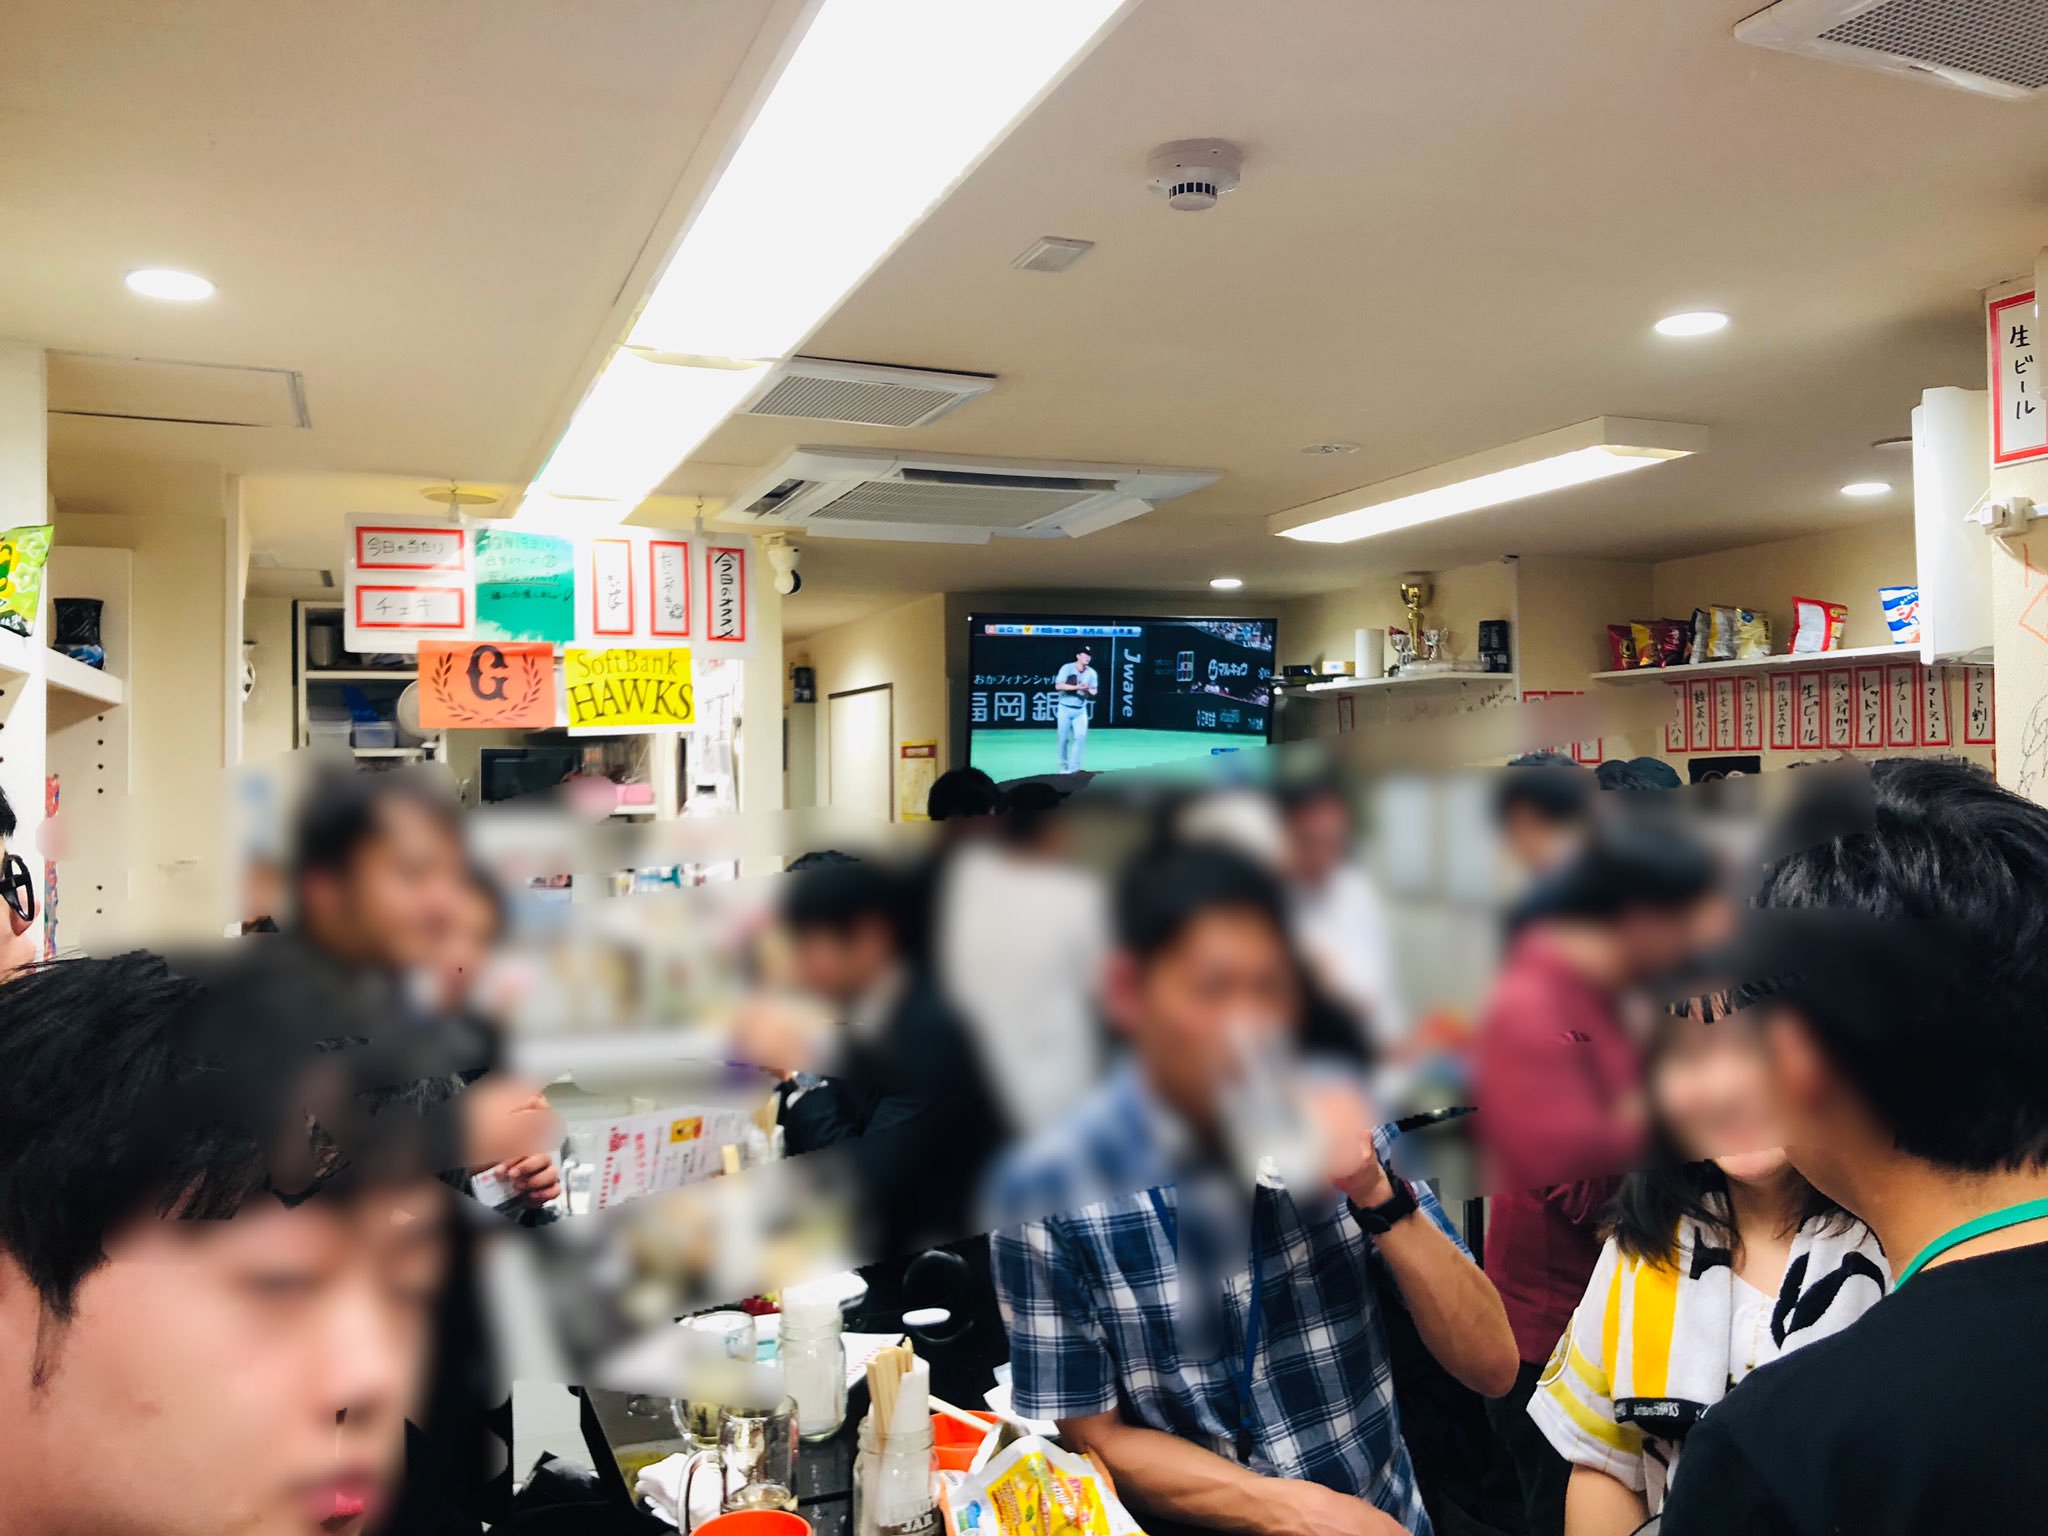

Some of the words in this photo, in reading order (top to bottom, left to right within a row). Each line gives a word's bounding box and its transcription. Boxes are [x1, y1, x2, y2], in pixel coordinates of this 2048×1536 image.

[2009, 324, 2036, 420] 生ビール
[374, 595, 433, 617] チェキ
[465, 643, 509, 702] G
[577, 648, 680, 679] SoftBank
[1218, 662, 1249, 676] マルキョウ
[565, 678, 694, 724] HAWKS
[1719, 684, 1730, 746] レモンサワー
[1776, 680, 1788, 745] カルピスサワー
[1802, 684, 1819, 742] 生ビール
[1832, 675, 1849, 741] シャンディガフ
[1862, 676, 1879, 742] レッドアイ
[1894, 675, 1909, 739] チューハイ
[1927, 669, 1940, 739] トマトジュース
[1971, 667, 1987, 737] トマト割り
